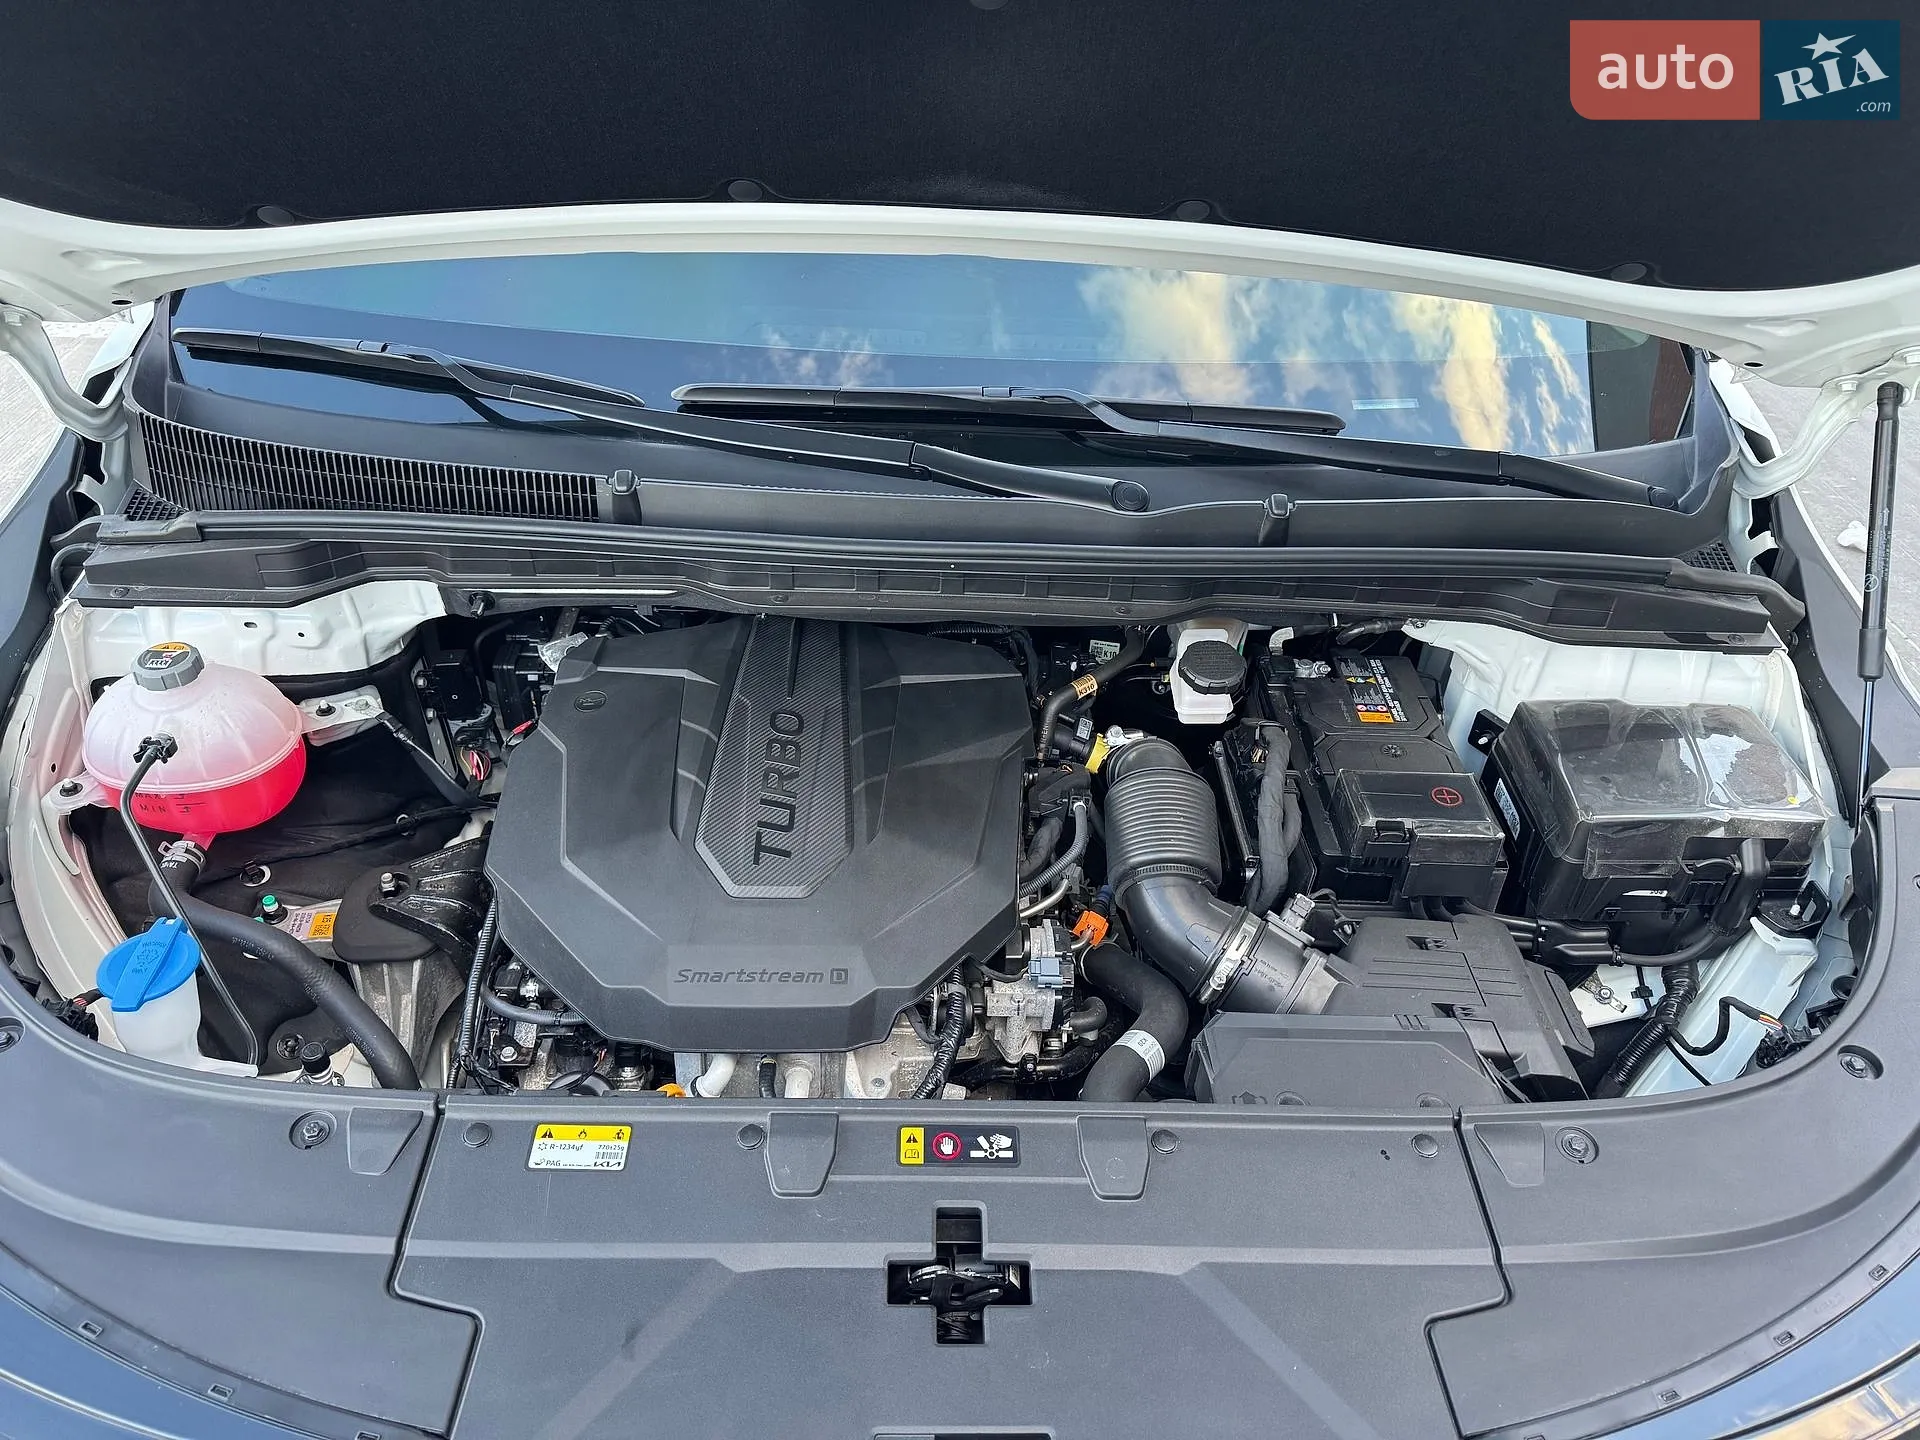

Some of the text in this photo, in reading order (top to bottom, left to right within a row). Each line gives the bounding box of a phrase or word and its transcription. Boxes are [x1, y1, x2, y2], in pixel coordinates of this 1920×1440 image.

[753, 709, 805, 867] TURBO
[139, 803, 167, 814] MIN
[673, 968, 826, 984] Smartstream
[549, 1143, 584, 1151] R-1234yf
